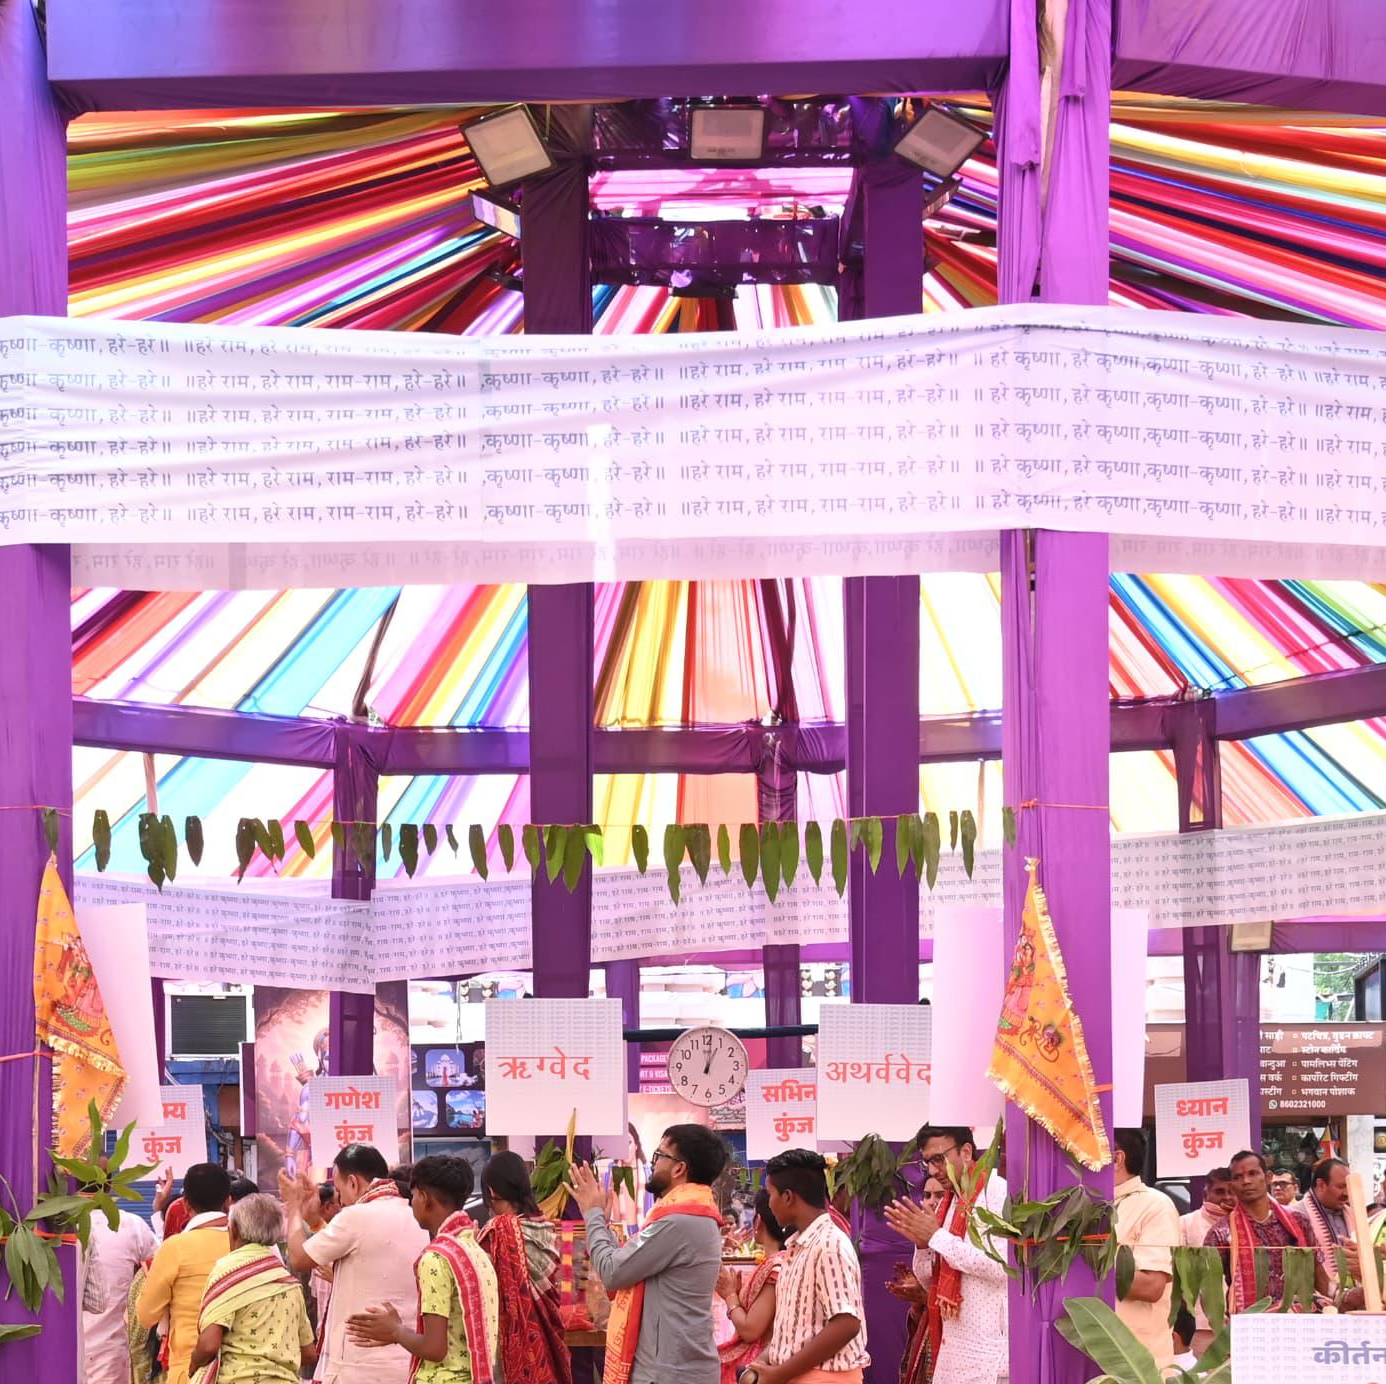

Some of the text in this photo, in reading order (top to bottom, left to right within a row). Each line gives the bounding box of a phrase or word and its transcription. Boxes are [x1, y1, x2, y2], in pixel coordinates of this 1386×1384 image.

[690, 1040, 699, 1050] 11
[702, 1035, 712, 1046] 12
[681, 1050, 691, 1060] 10
[728, 1047, 734, 1057] 2
[496, 1046, 593, 1081] ऋग्वेद
[676, 1062, 682, 1073] 9
[733, 1061, 740, 1071] 3
[825, 1053, 932, 1085] अथर्ववेद
[681, 1076, 688, 1086] 8
[728, 1075, 735, 1085] 4
[692, 1085, 698, 1095] 7
[705, 1088, 712, 1098] 6
[719, 1084, 725, 1095] 5
[324, 1086, 381, 1110] गणेश
[1175, 1095, 1229, 1120] ध्यान
[773, 1112, 814, 1143] कुंज
[1182, 1126, 1223, 1156] कुंज
[142, 1131, 182, 1163] कुंज
